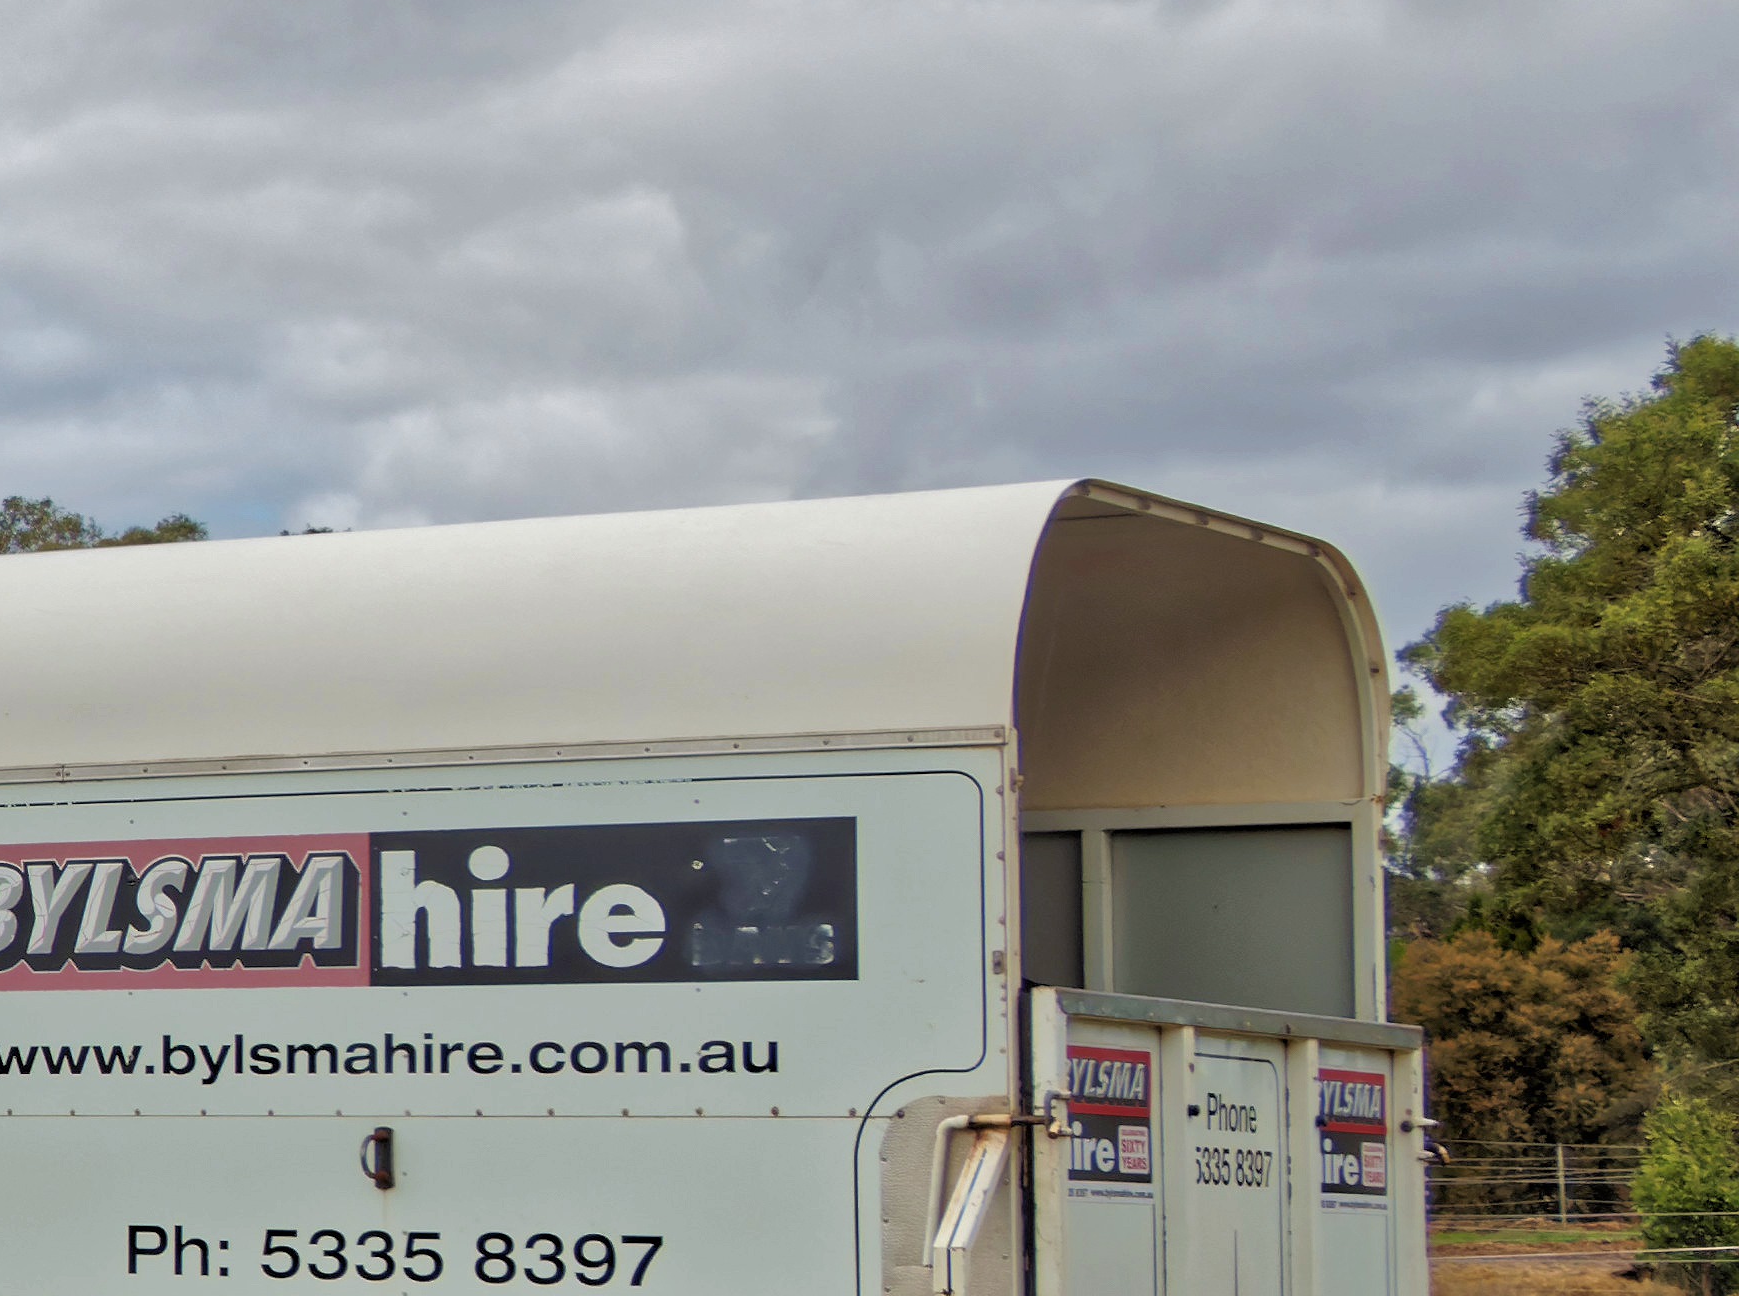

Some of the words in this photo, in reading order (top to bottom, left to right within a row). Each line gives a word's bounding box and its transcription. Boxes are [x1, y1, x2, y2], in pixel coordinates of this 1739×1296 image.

[381, 845, 666, 969] hire
[1069, 1057, 1148, 1102] YLSMA
[1320, 1079, 1383, 1120] YLSMA
[1207, 1092, 1257, 1134] Phone
[1070, 1120, 1116, 1173] ire
[1235, 1148, 1273, 1188] 8397
[1322, 1137, 1361, 1186] ire
[127, 1224, 229, 1277] Ph:
[260, 1229, 444, 1283] 5335
[474, 1231, 664, 1287] 8397
